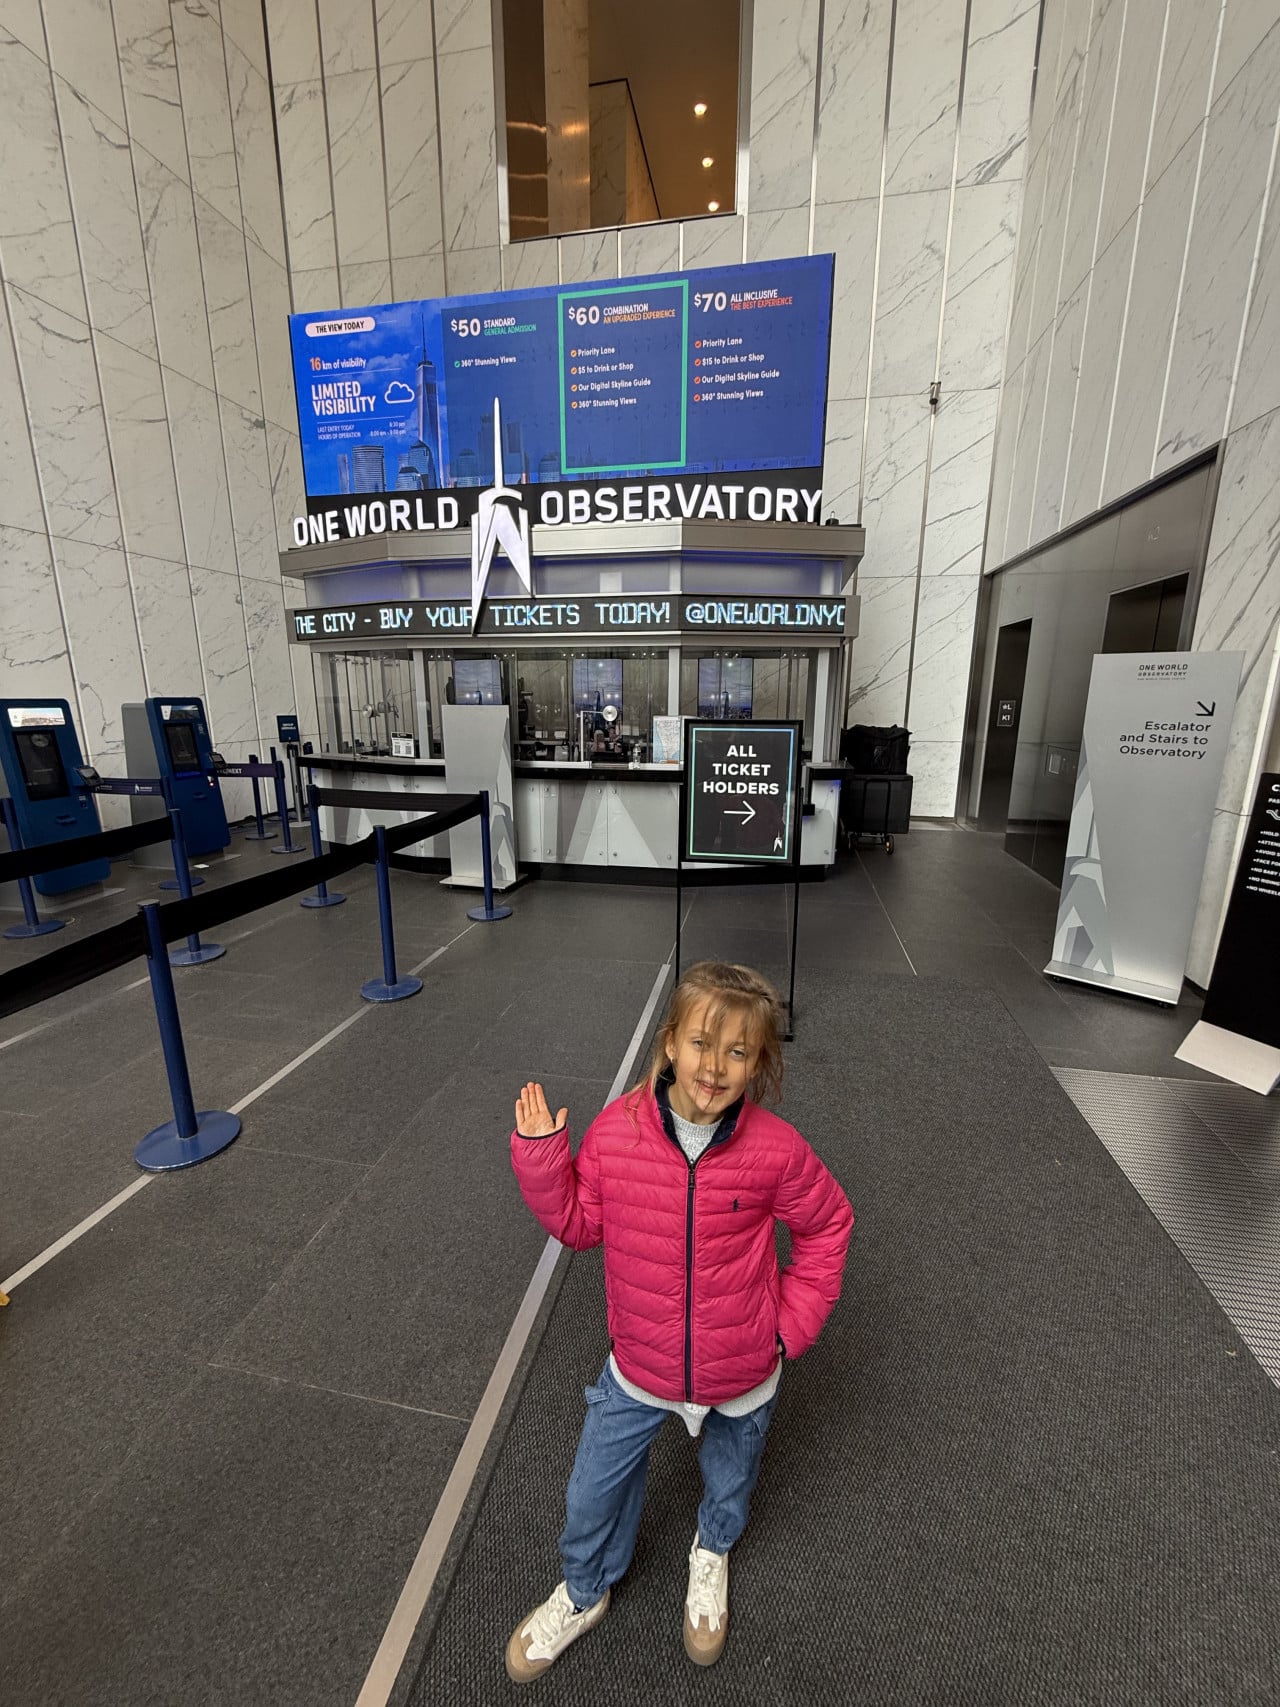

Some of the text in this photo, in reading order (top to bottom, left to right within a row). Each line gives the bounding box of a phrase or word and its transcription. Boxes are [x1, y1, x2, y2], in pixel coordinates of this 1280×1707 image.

[694, 292, 727, 312] $70
[731, 289, 778, 303] ALL INCLUSIVE
[603, 303, 648, 316] COMBINATION
[731, 297, 792, 311] THE BEST EXPERIENCE
[568, 306, 600, 326] $60
[603, 309, 676, 324] AN UPGRADED EXPERIENCE
[316, 321, 365, 334] THE VIEW TODAY
[450, 318, 480, 337] $50
[484, 318, 516, 328] STANDARD
[484, 324, 536, 336] GENERAL ADMISSION
[702, 337, 742, 348] Priority Lane
[578, 346, 615, 357] Priority Lane
[310, 357, 366, 371] 16 km of visibility
[475, 358, 499, 366] Stunning
[500, 356, 516, 364] Views
[702, 358, 712, 366] $15
[722, 355, 739, 364] Drink
[748, 353, 764, 362] Shop
[578, 366, 586, 375] $5
[594, 364, 610, 373] Drink
[619, 362, 634, 372] Shop
[702, 369, 779, 384] Our Digital Skyline Guide
[312, 381, 361, 400] LIMITED
[590, 382, 610, 392] Digital
[611, 380, 632, 390] Skyline
[633, 377, 651, 386] Guide
[717, 391, 744, 400] Stunning
[745, 390, 764, 398] Views
[312, 396, 376, 416] VISIBILITY
[592, 399, 618, 408] Stunning
[620, 397, 636, 405] Views
[339, 431, 361, 439] OPERATION
[293, 483, 823, 546] ONE WORLD OBSERVATORY
[294, 615, 316, 634] THE
[322, 612, 356, 632] CITY
[379, 608, 413, 628] BUY
[426, 606, 472, 628] YOUR
[489, 604, 580, 626] TICKETS
[595, 602, 670, 624] TODAY!
[686, 602, 845, 626] @ONEWORLDNYC
[1144, 721, 1212, 732] Escalator
[1120, 734, 1208, 745] and Stairs to
[727, 745, 757, 757] ALL
[1120, 745, 1206, 760] Observatory
[712, 763, 771, 776] TICKET
[703, 781, 779, 795] HOLDERS
